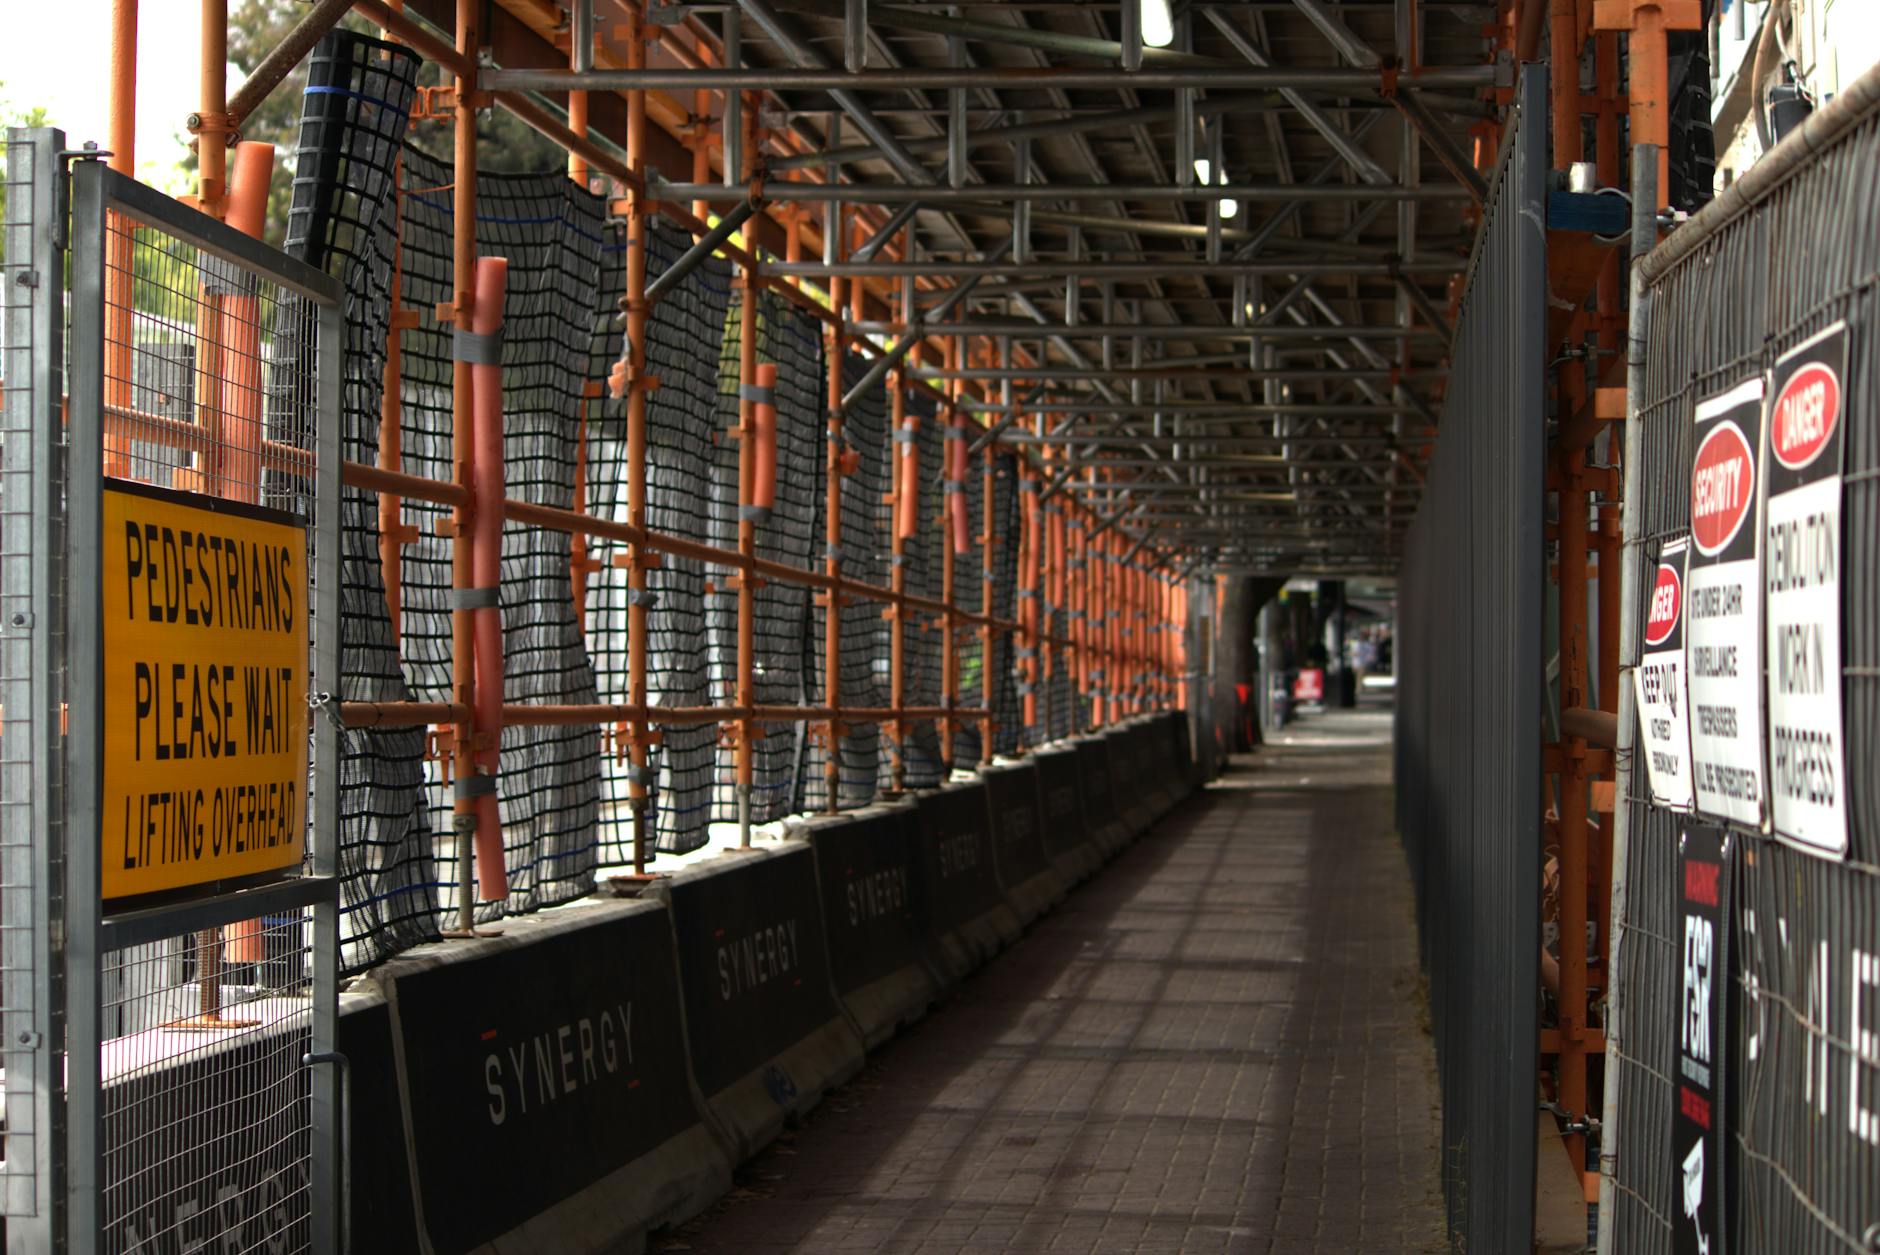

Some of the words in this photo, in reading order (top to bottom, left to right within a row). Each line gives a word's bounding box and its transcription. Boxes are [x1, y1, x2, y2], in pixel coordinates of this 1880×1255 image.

[1781, 381, 1826, 453] DANGER
[1694, 456, 1743, 519] SECURITY
[125, 520, 293, 634] PEDESTRIANS
[1768, 511, 1836, 593] DEMOLITION
[1777, 622, 1811, 694] WORK
[135, 662, 236, 761] PLEASE
[243, 667, 292, 755] WAIT
[1774, 726, 1835, 806] PROGRESS
[123, 787, 204, 870] LIFTING
[211, 780, 296, 858] OVERHEAD
[846, 864, 908, 927] SYNERGY
[717, 917, 799, 1001] SYNERGY
[484, 1001, 634, 1127] SYNERGY
